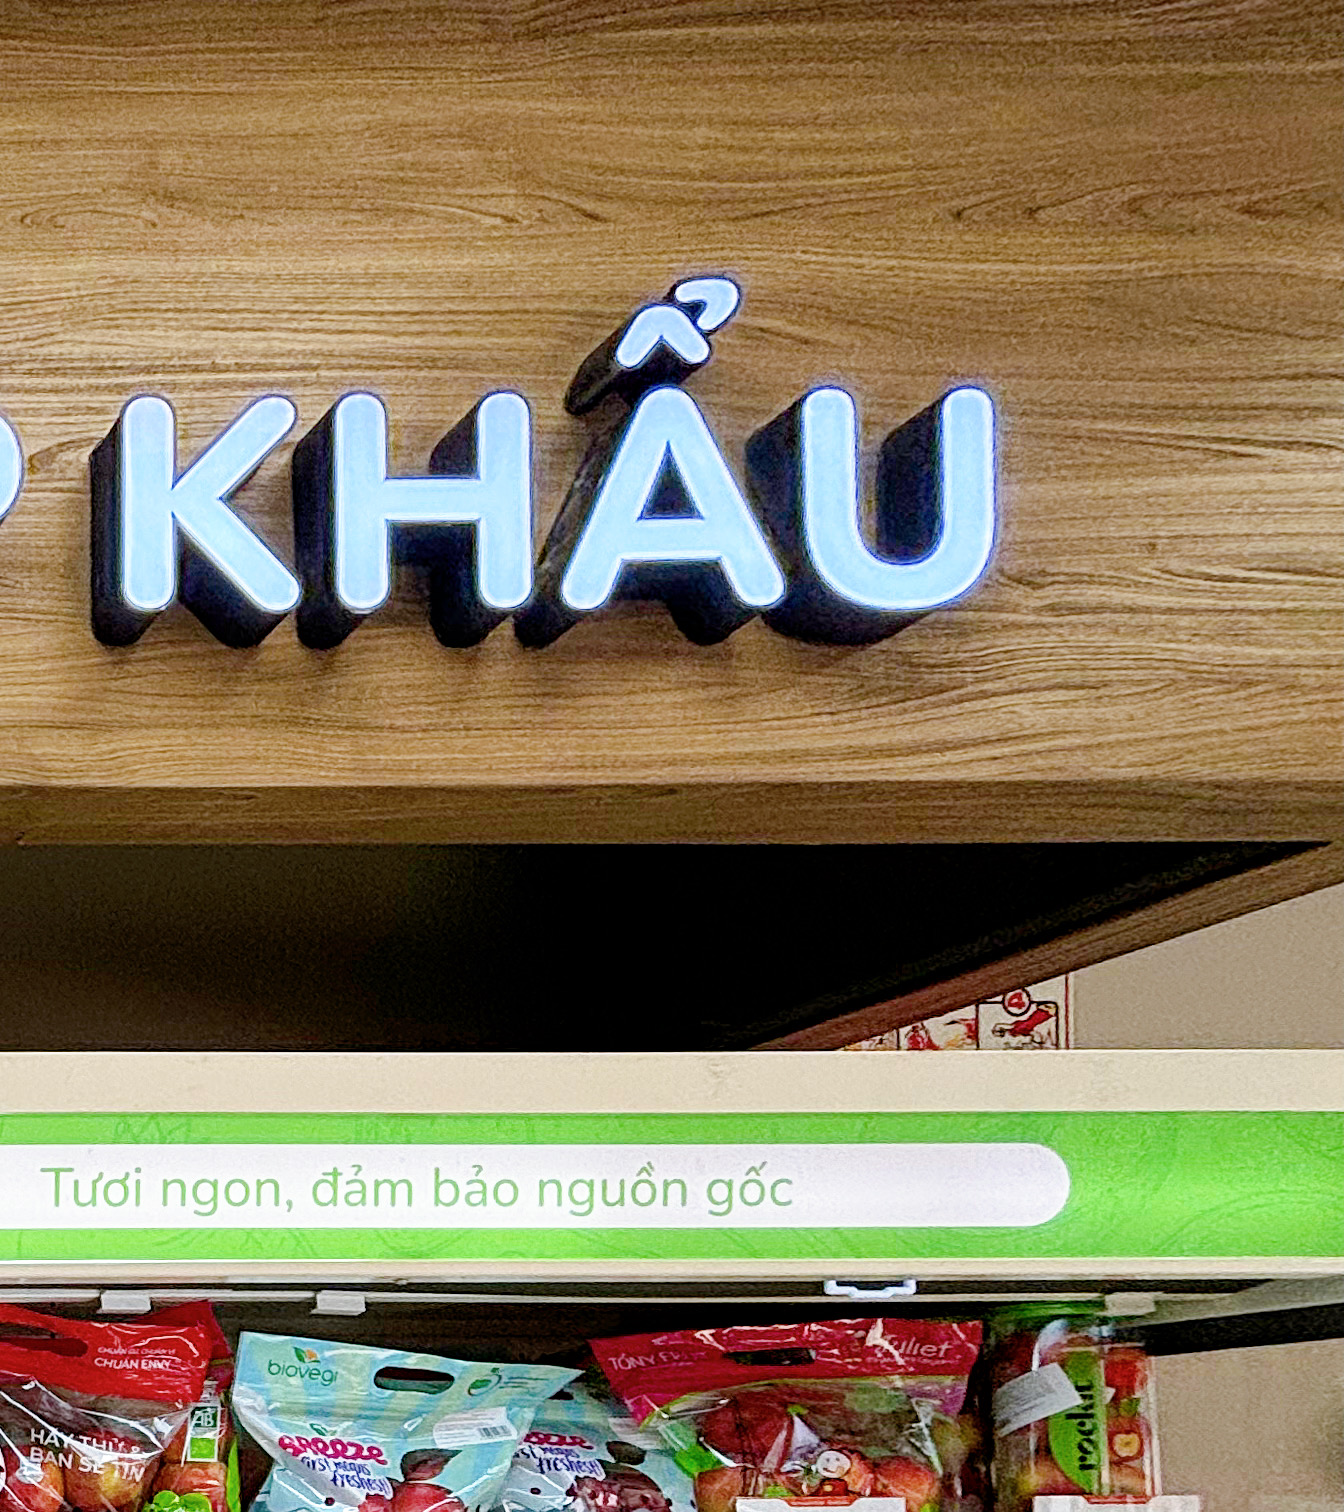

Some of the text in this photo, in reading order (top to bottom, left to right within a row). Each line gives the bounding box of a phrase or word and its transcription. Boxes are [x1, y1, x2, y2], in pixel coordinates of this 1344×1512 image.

[120, 273, 996, 614] KHẨU
[41, 1158, 794, 1222] Tươi ngon, đảm bảo nguồn gốc
[267, 1359, 338, 1386] biovegi
